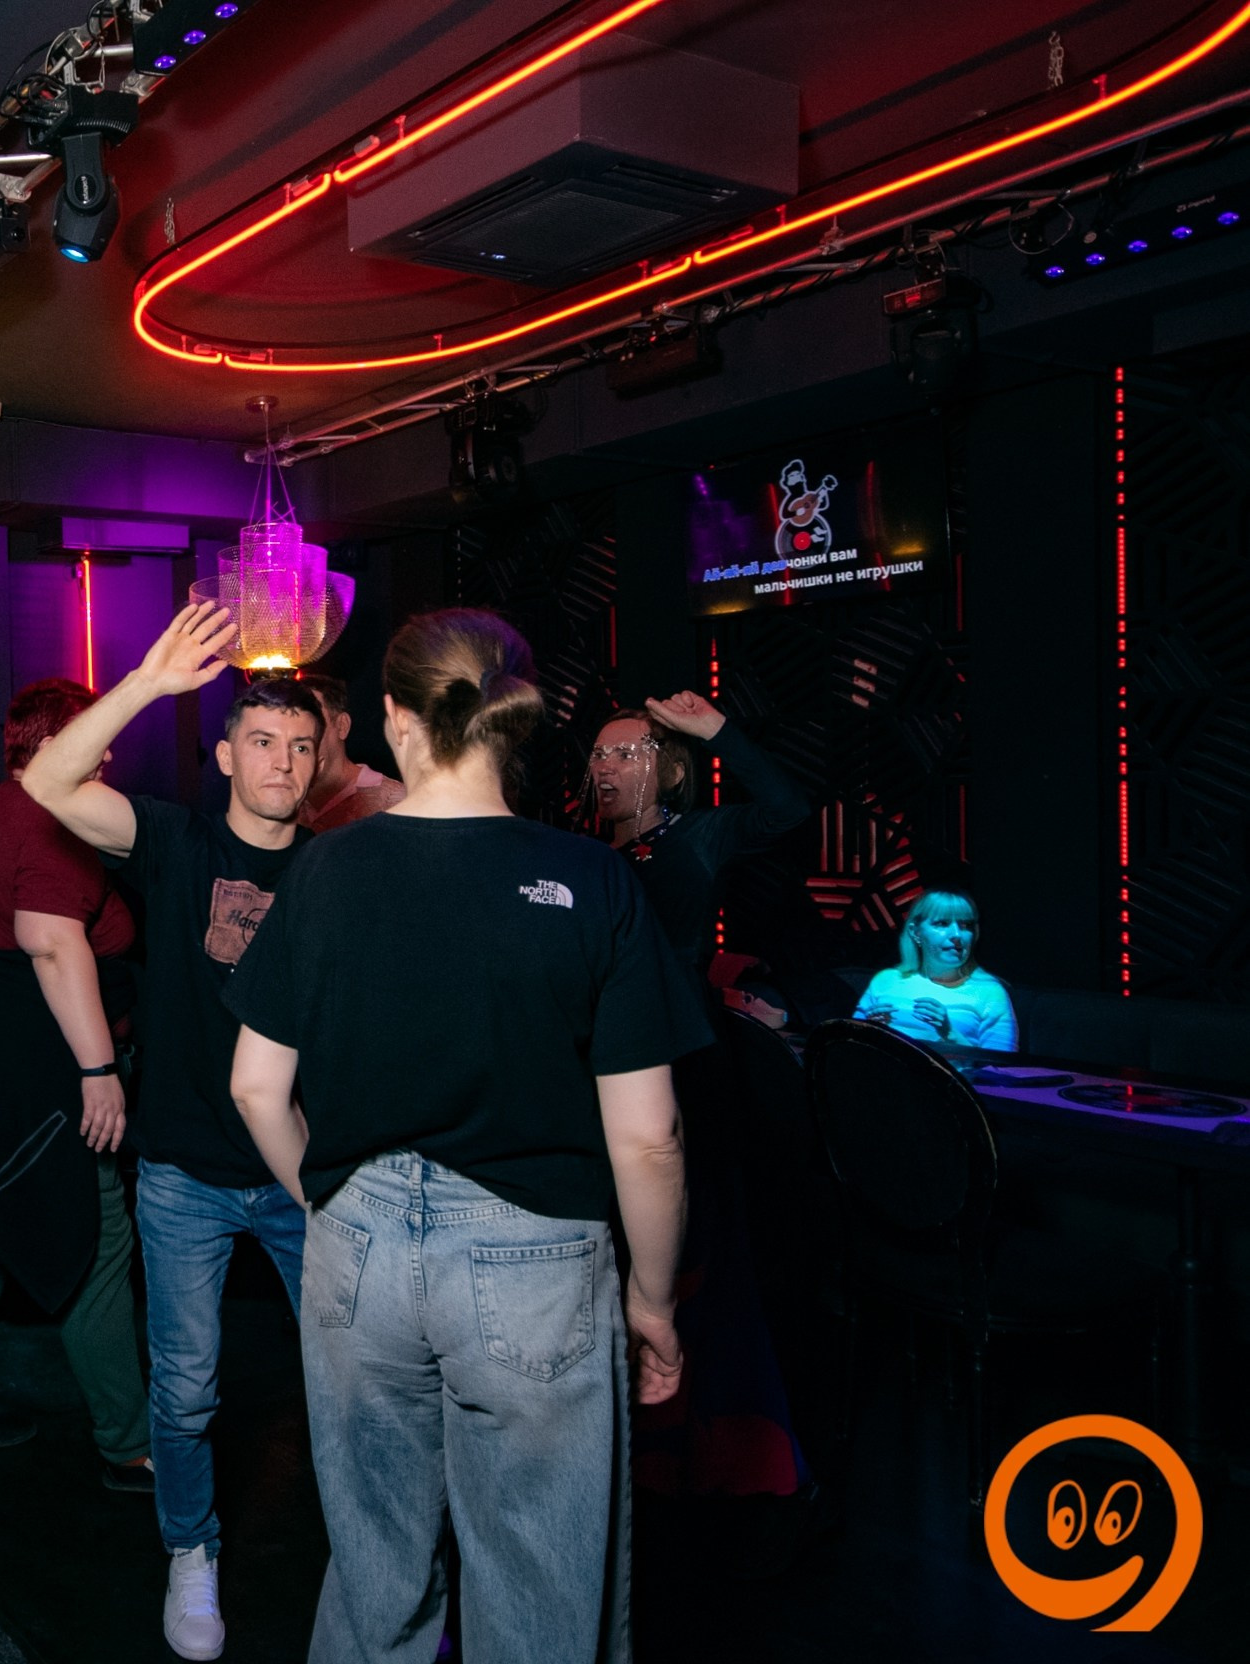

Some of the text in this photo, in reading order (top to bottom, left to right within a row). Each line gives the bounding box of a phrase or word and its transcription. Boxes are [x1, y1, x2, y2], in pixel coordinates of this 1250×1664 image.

[830, 548, 858, 562] вам
[754, 560, 924, 594] мальчишки не игрушки
[536, 879, 557, 889] THE
[519, 885, 557, 896] NORTH
[529, 895, 556, 905] FACE
